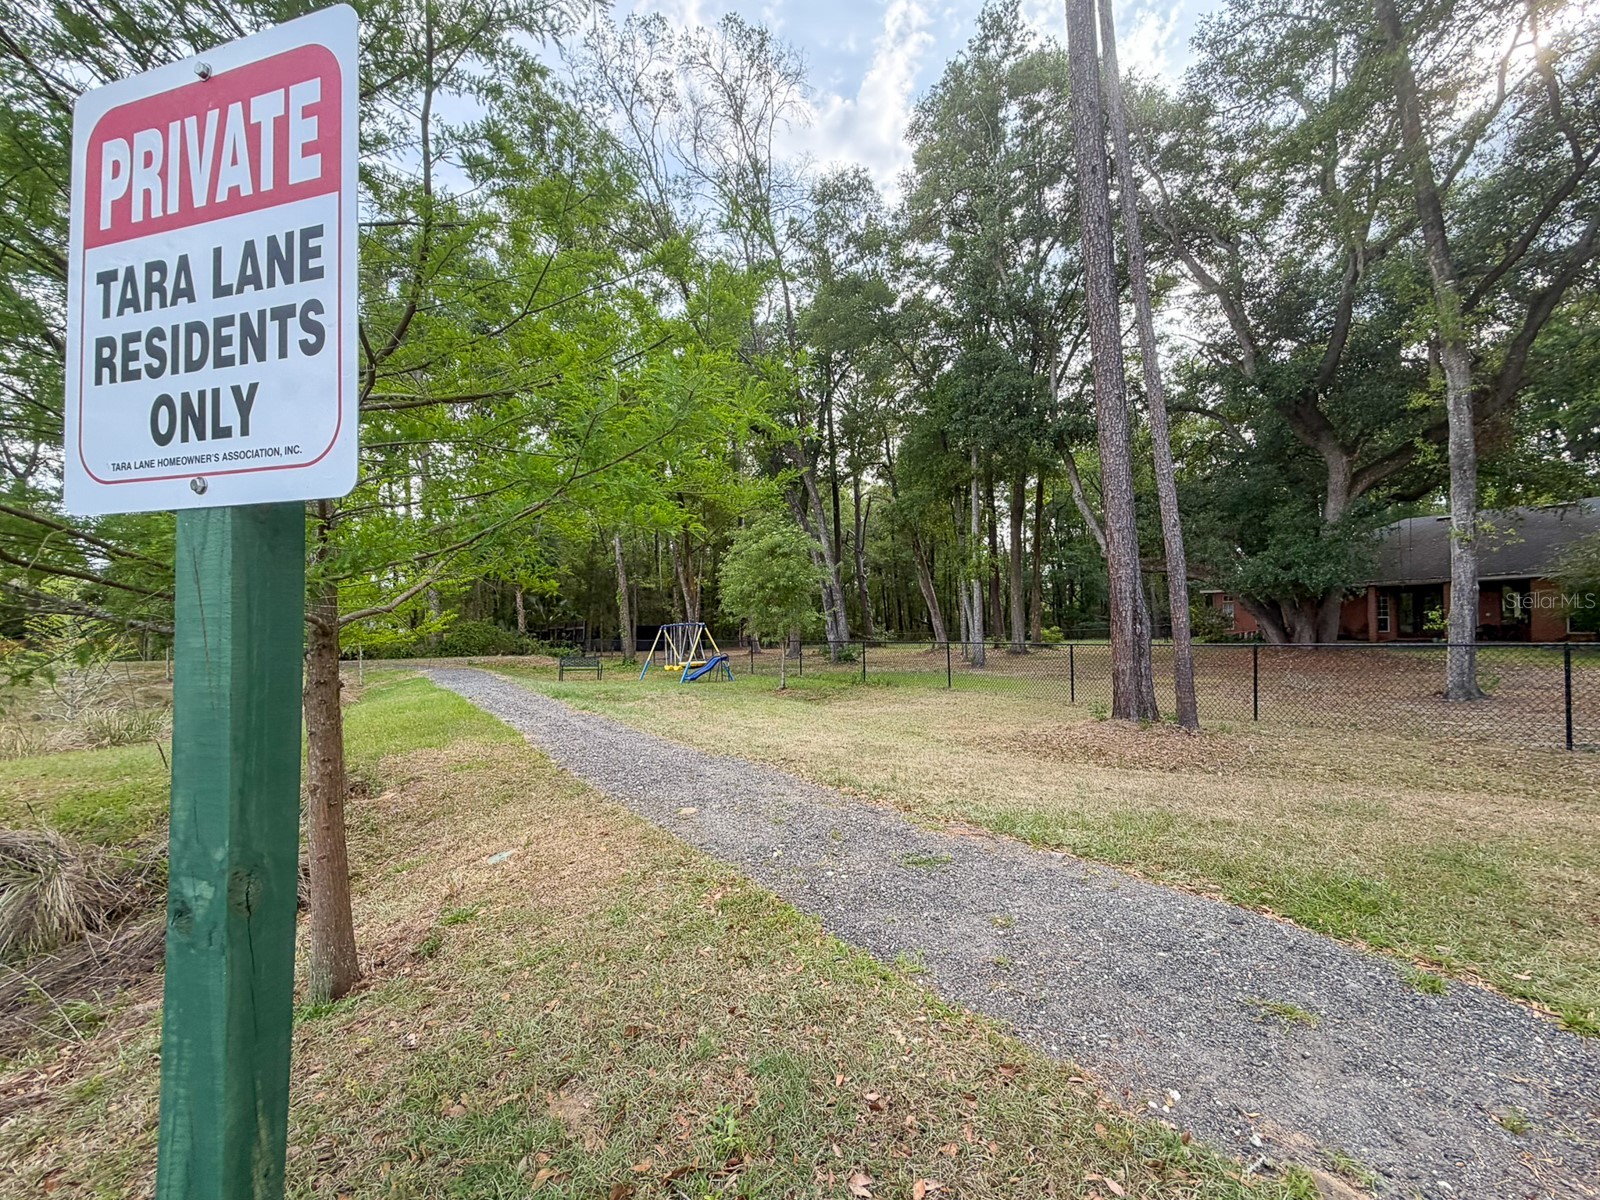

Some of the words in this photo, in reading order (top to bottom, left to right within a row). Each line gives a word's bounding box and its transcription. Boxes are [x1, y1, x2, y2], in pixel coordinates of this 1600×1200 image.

[100, 76, 321, 231] PRIVATE
[96, 253, 196, 320] TARA
[212, 223, 325, 300] LANE
[94, 298, 326, 386] RESIDENTS
[111, 462, 132, 472] TARA
[134, 460, 156, 470] LANE
[157, 453, 220, 468] HOMEOWNER'S
[221, 447, 283, 462] ASSOCIATION,
[284, 444, 303, 455] INC.
[150, 381, 260, 447] ONLY
